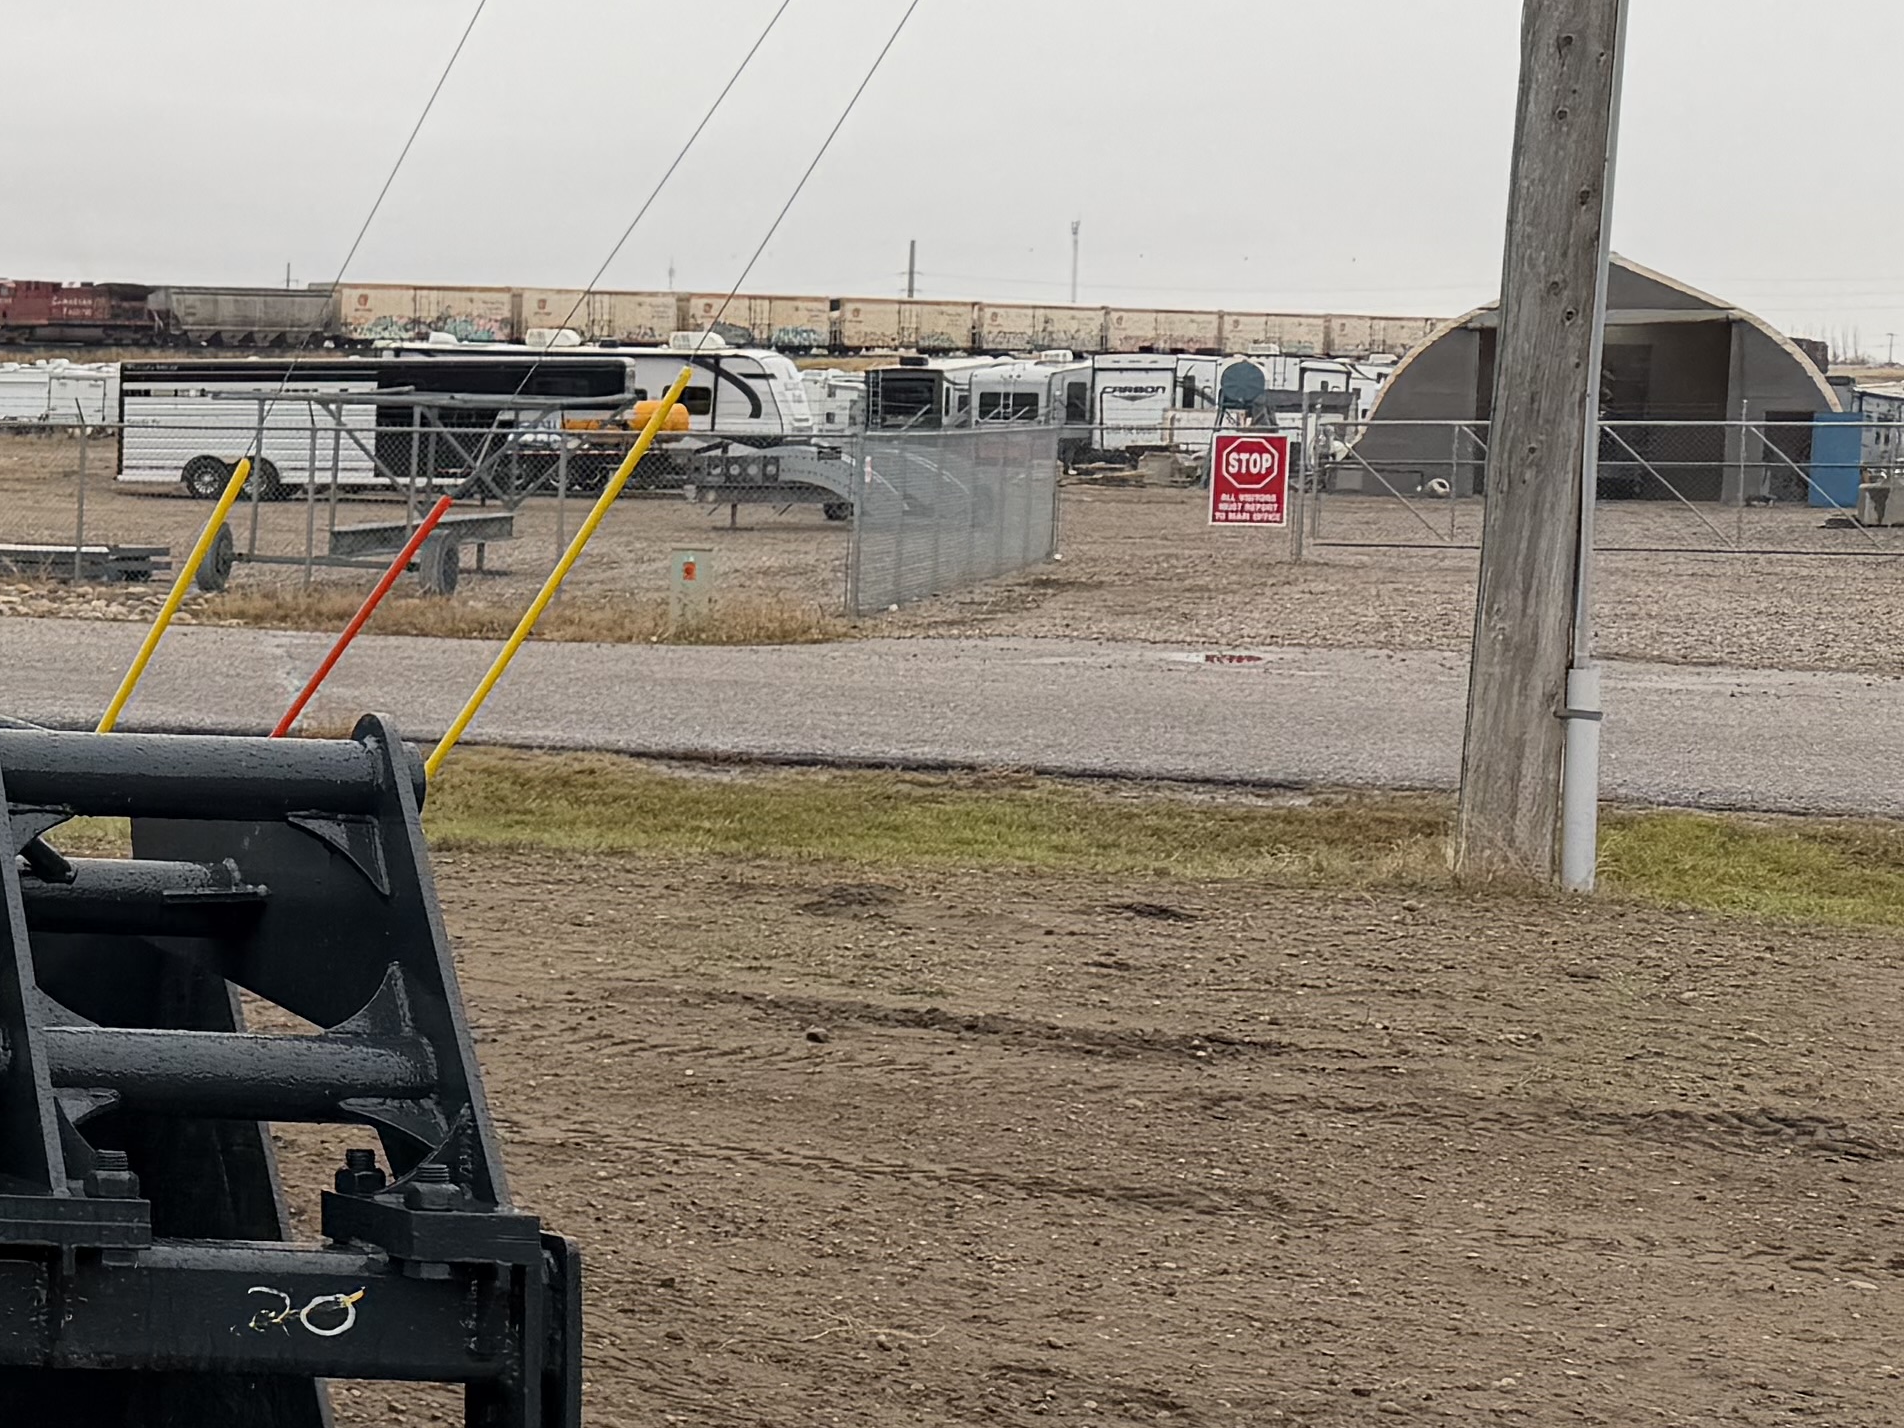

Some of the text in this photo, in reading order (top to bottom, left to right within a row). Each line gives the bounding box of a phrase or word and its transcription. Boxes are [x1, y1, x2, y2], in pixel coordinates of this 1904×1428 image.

[1228, 452, 1273, 474] STOP
[1221, 494, 1236, 502] ALL
[1244, 504, 1278, 512] REPORT
[1215, 512, 1281, 521] TO MAIN OFFICE
[246, 1286, 364, 1336] 20
